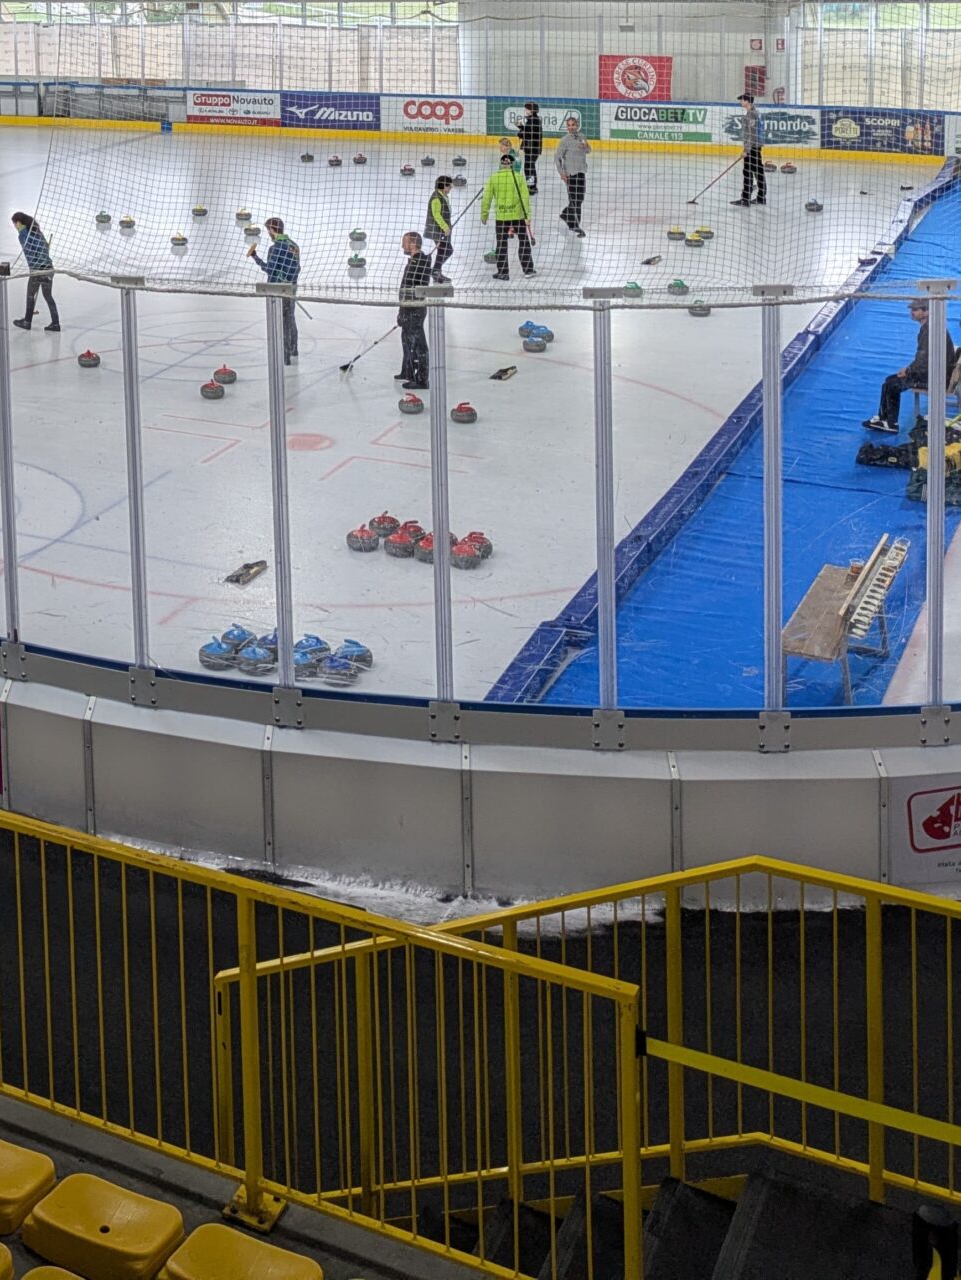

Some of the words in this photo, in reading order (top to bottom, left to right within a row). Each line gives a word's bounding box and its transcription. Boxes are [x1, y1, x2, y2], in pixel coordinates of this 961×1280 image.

[194, 94, 230, 106] Gruppo
[232, 95, 274, 105] Novauto
[403, 100, 463, 125] coop
[865, 118, 900, 126] SCOPRI
[637, 131, 669, 139] CANALE
